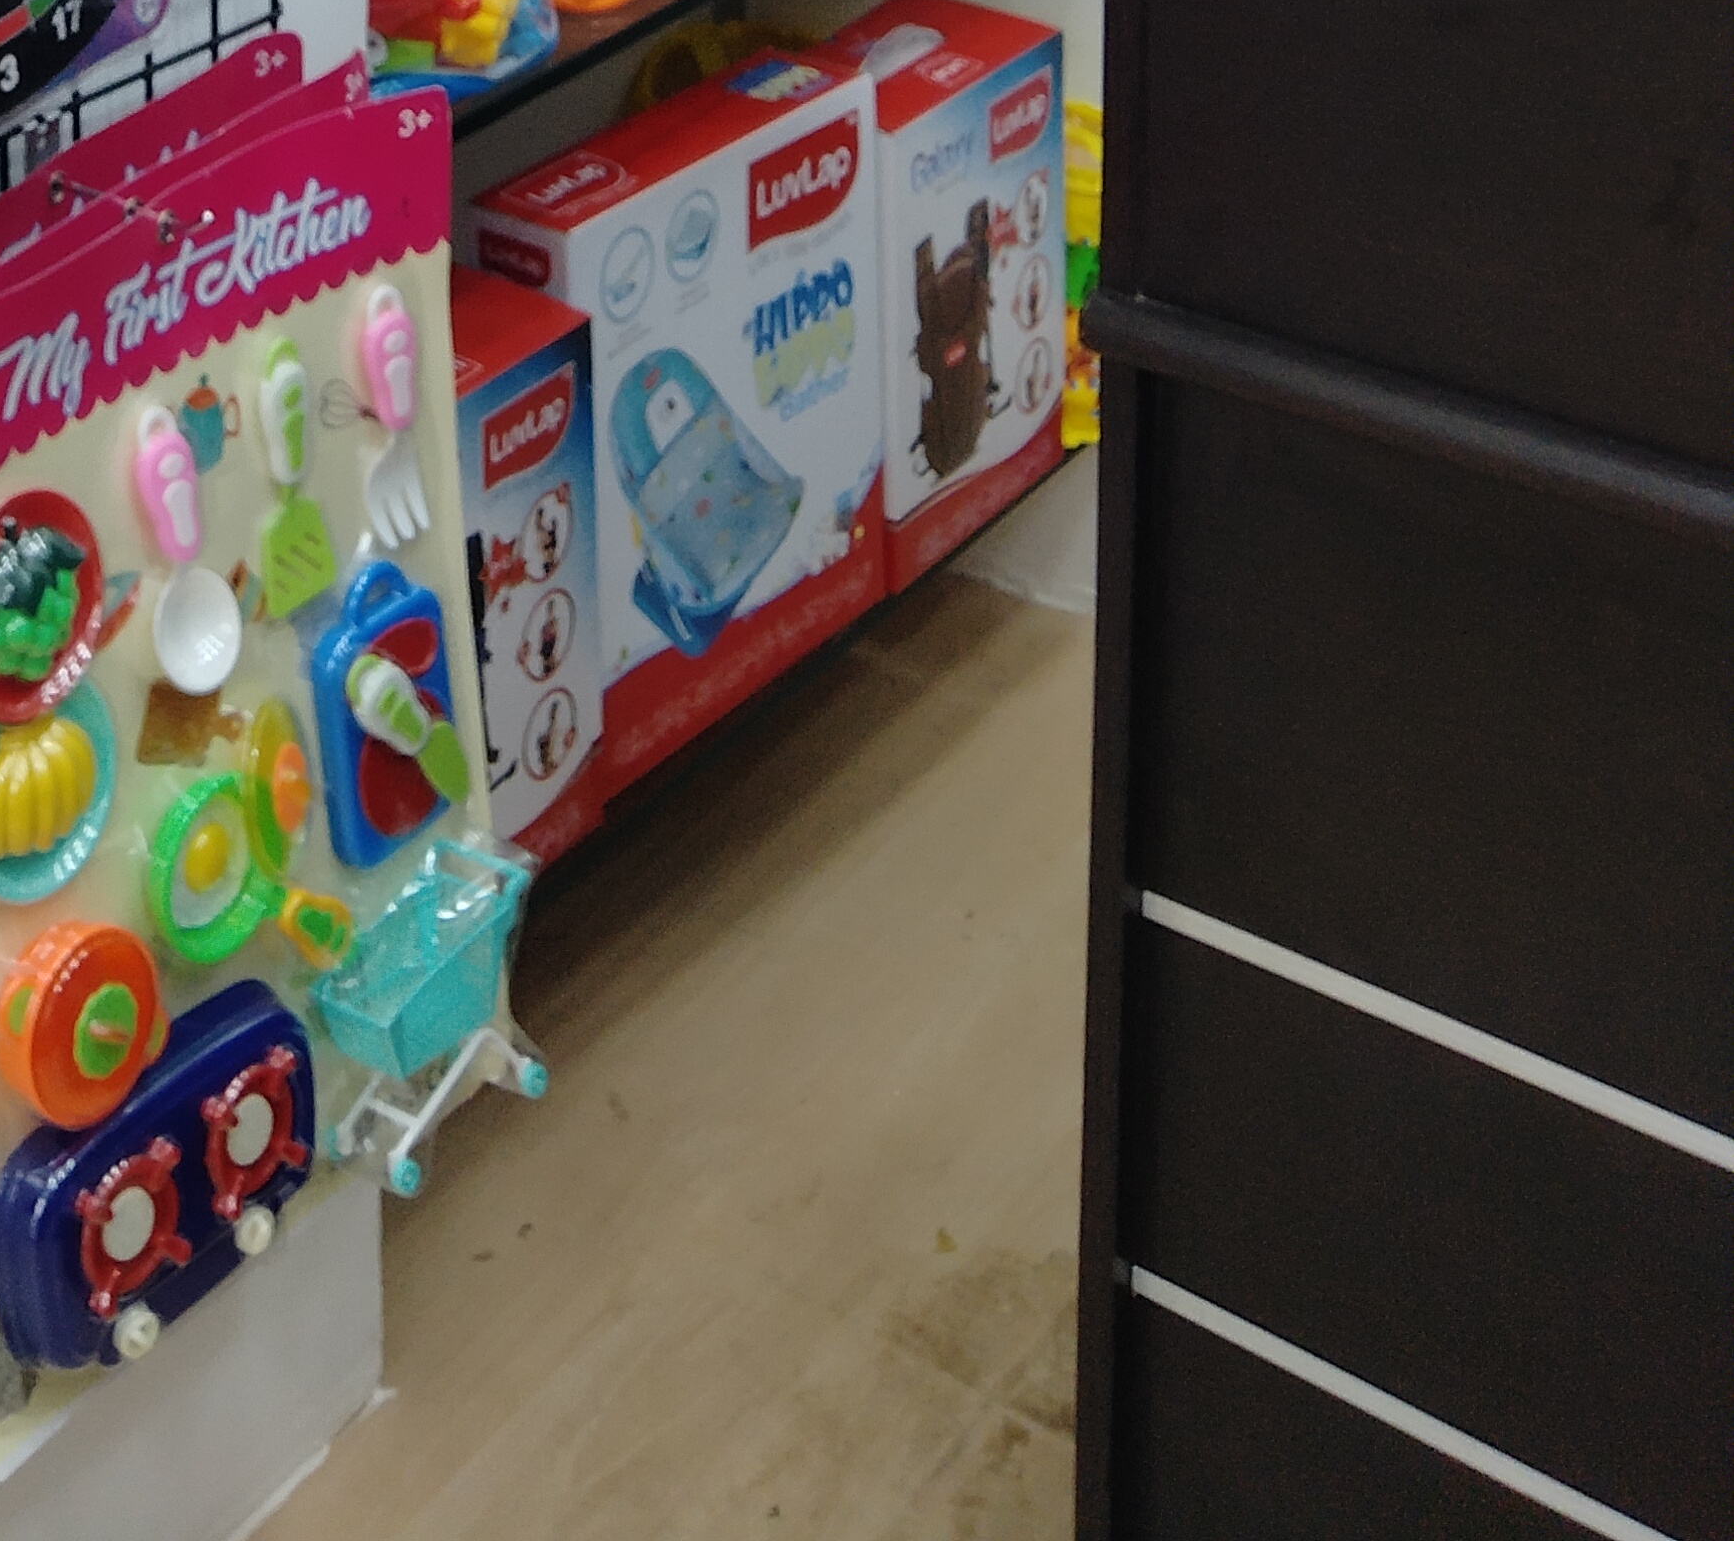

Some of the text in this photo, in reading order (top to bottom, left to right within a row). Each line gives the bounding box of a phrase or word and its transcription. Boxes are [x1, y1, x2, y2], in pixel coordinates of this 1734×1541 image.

[397, 109, 435, 140] 3+
[755, 144, 853, 219] LuvLap
[102, 242, 221, 367] First
[194, 177, 372, 312] Kitchen
[488, 395, 567, 465] LuvLap
